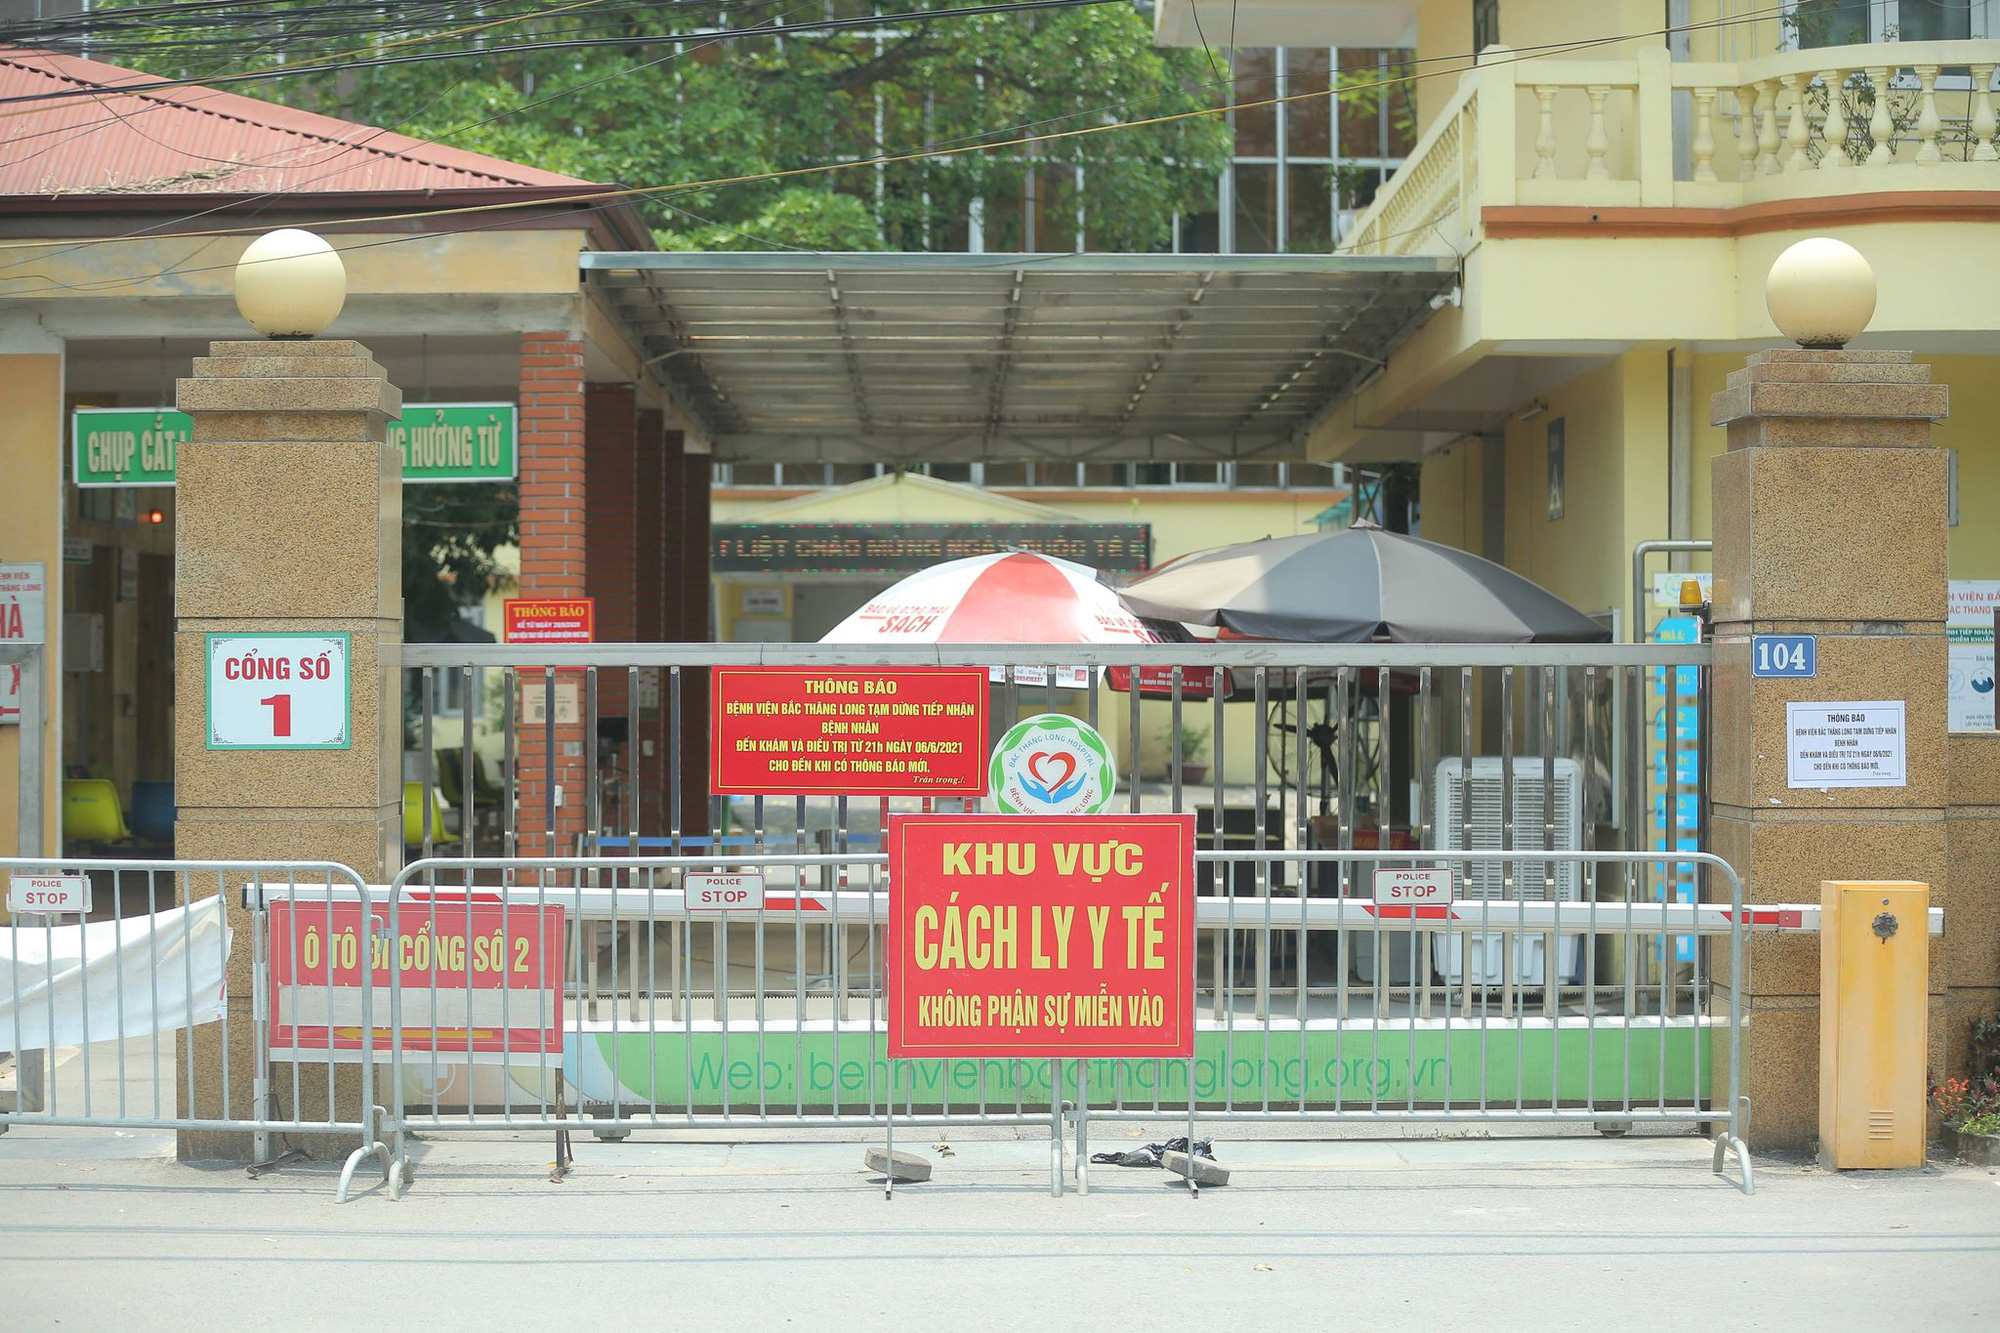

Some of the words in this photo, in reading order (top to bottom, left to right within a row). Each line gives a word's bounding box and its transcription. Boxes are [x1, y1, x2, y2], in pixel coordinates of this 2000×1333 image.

[87, 431, 136, 481] CHỤP
[141, 414, 175, 473] CẮT
[411, 409, 472, 468] HƯỞNG
[477, 414, 502, 468] TỪ
[514, 604, 557, 617] THÔNG
[559, 604, 585, 617] BÁO
[225, 647, 291, 680] CỔNG
[299, 650, 332, 680] SỐ
[1758, 643, 1806, 671] 104
[804, 677, 859, 694] THÔNG
[864, 678, 898, 695] BÁO
[260, 694, 291, 737] 1
[726, 700, 754, 717] BỆNH
[756, 700, 779, 717] VIỆN
[781, 699, 801, 715] BẮC
[804, 701, 837, 716] THĂNG
[839, 703, 865, 716] LONG
[868, 703, 889, 718] TẠM
[892, 700, 920, 716] DỪNG
[922, 700, 944, 716] TIẾP
[946, 702, 975, 719] NHẬN
[1827, 712, 1850, 723] THÔNG
[1851, 712, 1866, 723] BÁO
[821, 719, 848, 736] BỆNH
[851, 719, 879, 734] NHÂN
[735, 736, 757, 752] ĐẾN
[759, 738, 789, 752] KHÁM
[791, 738, 804, 752] VÀ
[806, 736, 830, 752] ĐIỀU
[832, 740, 848, 755] TRỊ
[850, 738, 864, 753] TỪ
[865, 741, 884, 753] 21h
[886, 738, 913, 753] NGÀY
[915, 741, 963, 754] 06/6/2021
[1018, 735, 1043, 753] THANG
[1045, 733, 1066, 743] LONG
[1067, 738, 1095, 767] HOSPITAL
[769, 759, 789, 772] CHO
[791, 755, 812, 772] ĐẾN
[814, 759, 832, 772] KHI
[834, 758, 848, 773] CÓ
[850, 758, 883, 773] THÔNG
[885, 759, 906, 773] BÁO
[908, 757, 931, 774] MỚI.
[1081, 788, 1094, 808] LONG
[943, 843, 1036, 876] KHU
[1052, 840, 1144, 883] VỰC
[31, 880, 62, 888] POLICE
[1391, 885, 1437, 898] STOP
[25, 892, 68, 905] STOP
[701, 890, 748, 903] STOP
[914, 891, 1017, 970] CÁCH
[1031, 905, 1075, 970] LY
[1087, 905, 1110, 970] Y
[1122, 882, 1170, 970] TẾ
[304, 925, 320, 969] Ô
[331, 925, 357, 970] TÔ
[399, 920, 466, 972] CỔNG
[513, 936, 529, 973] 2
[918, 988, 982, 1027] KHÔNG
[987, 988, 1038, 1034] PHẬN
[1044, 991, 1071, 1034] SỰ
[1074, 982, 1122, 1027] MIỄN
[1128, 988, 1163, 1027] VÀO
[690, 1052, 792, 1091] Web:
